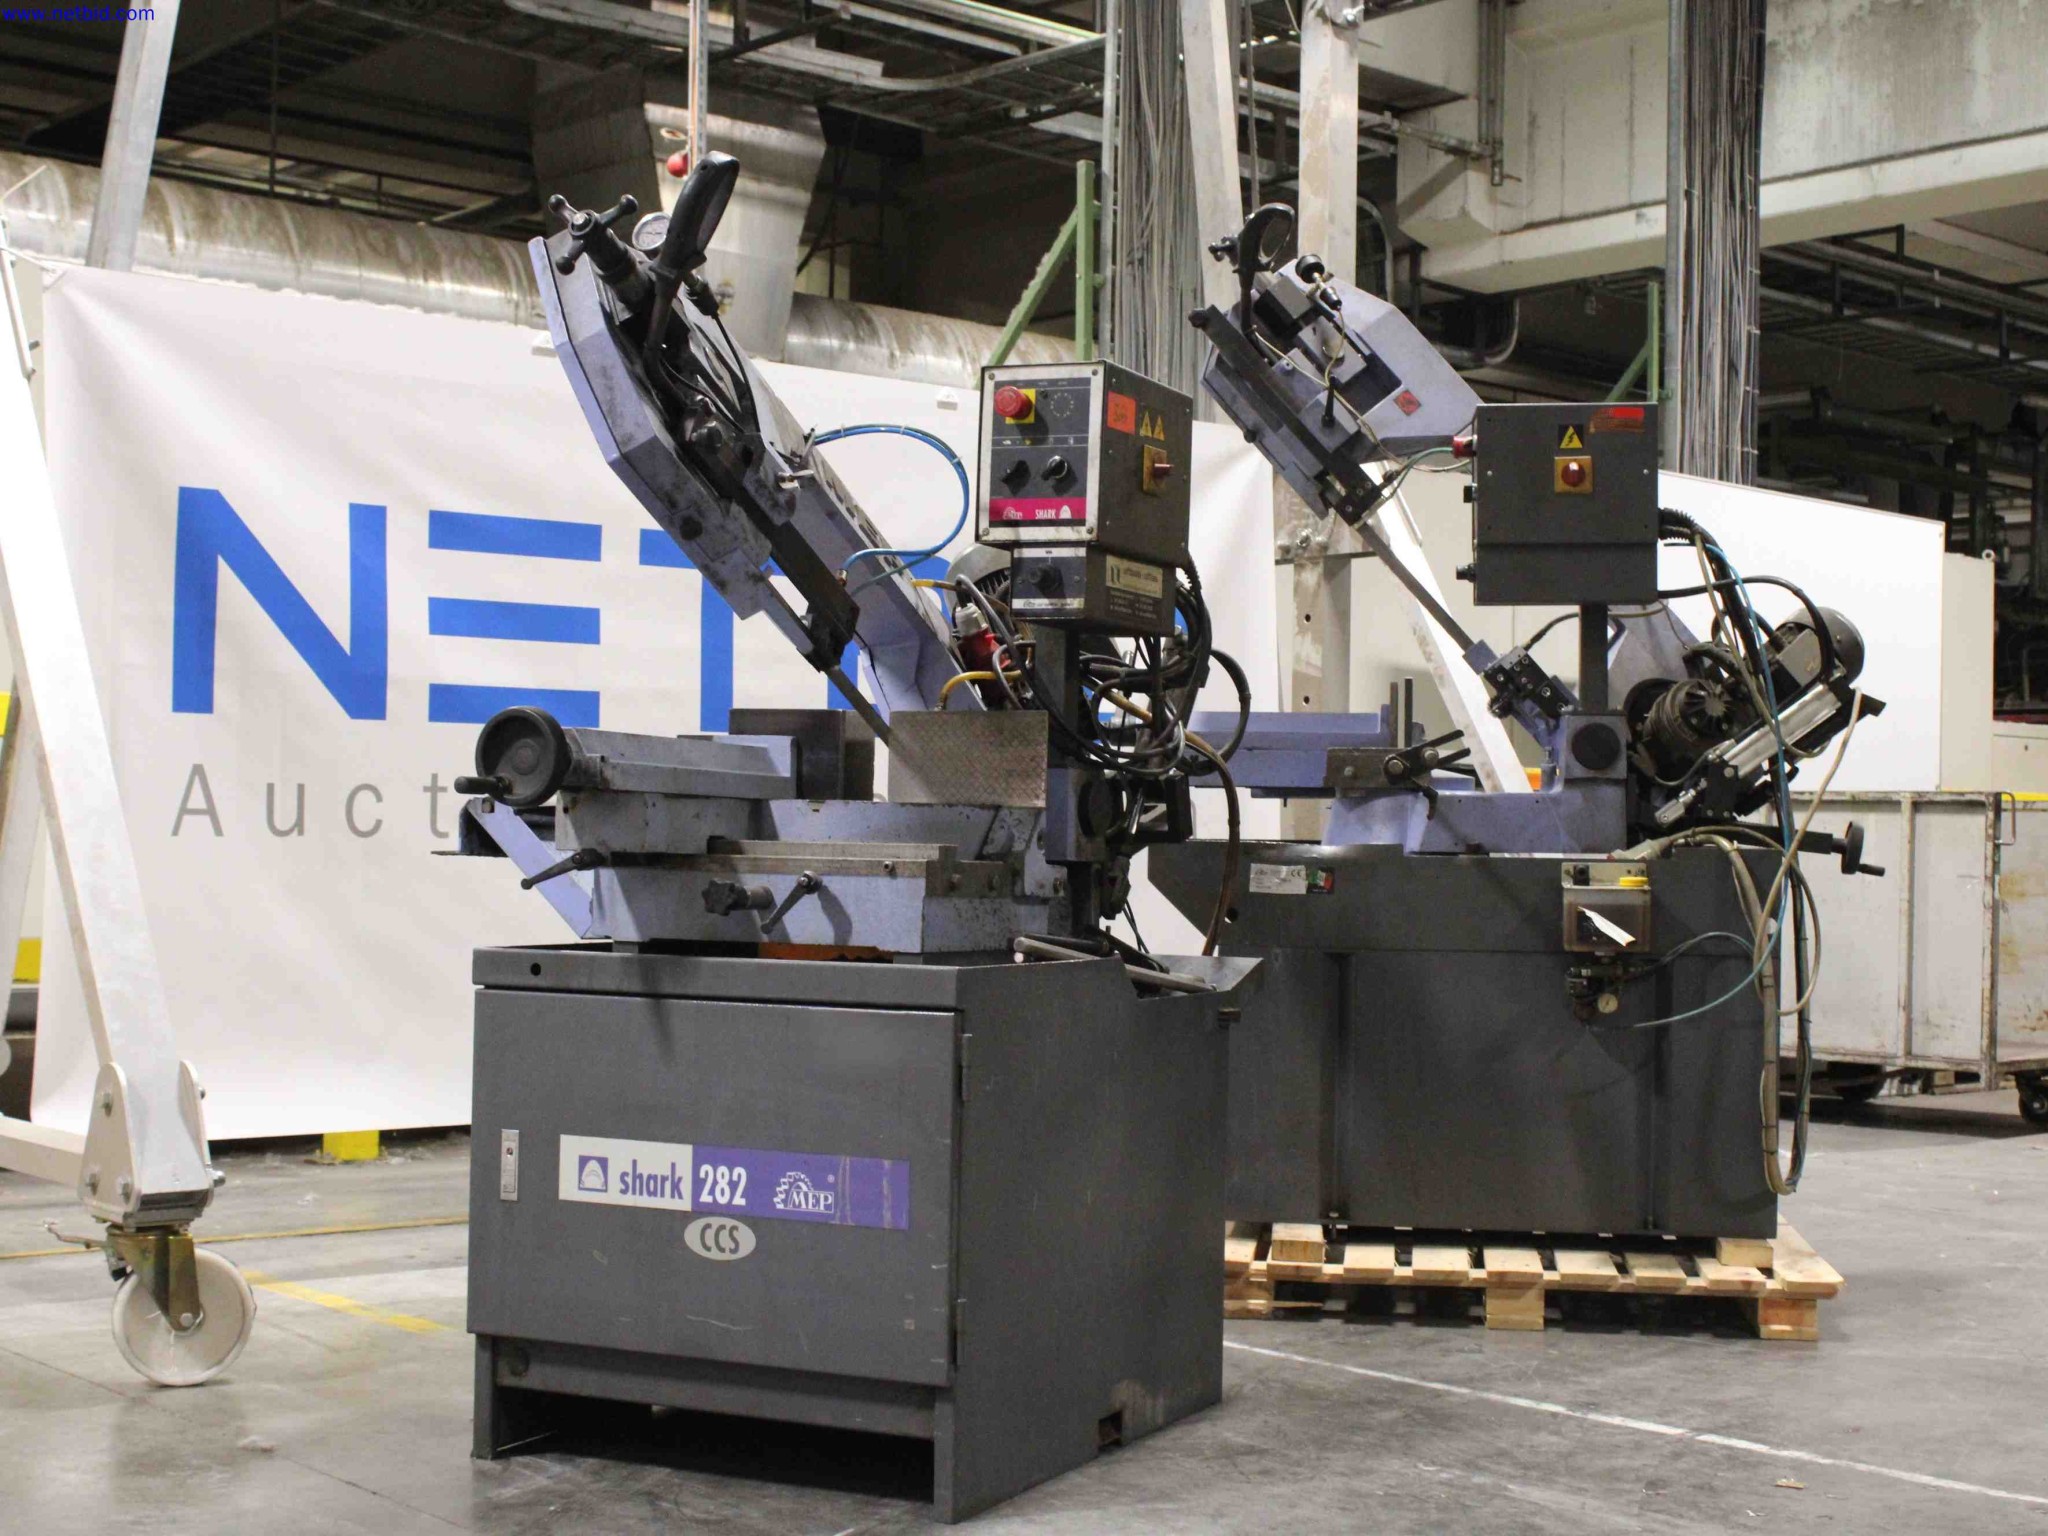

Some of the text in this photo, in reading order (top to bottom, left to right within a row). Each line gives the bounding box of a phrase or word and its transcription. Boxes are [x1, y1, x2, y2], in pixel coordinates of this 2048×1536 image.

[1035, 509, 1056, 519] SHARK
[171, 763, 450, 839] Auct
[619, 1159, 748, 1206] shark 282
[788, 1190, 833, 1213] MEP
[700, 1222, 740, 1253] CCS
